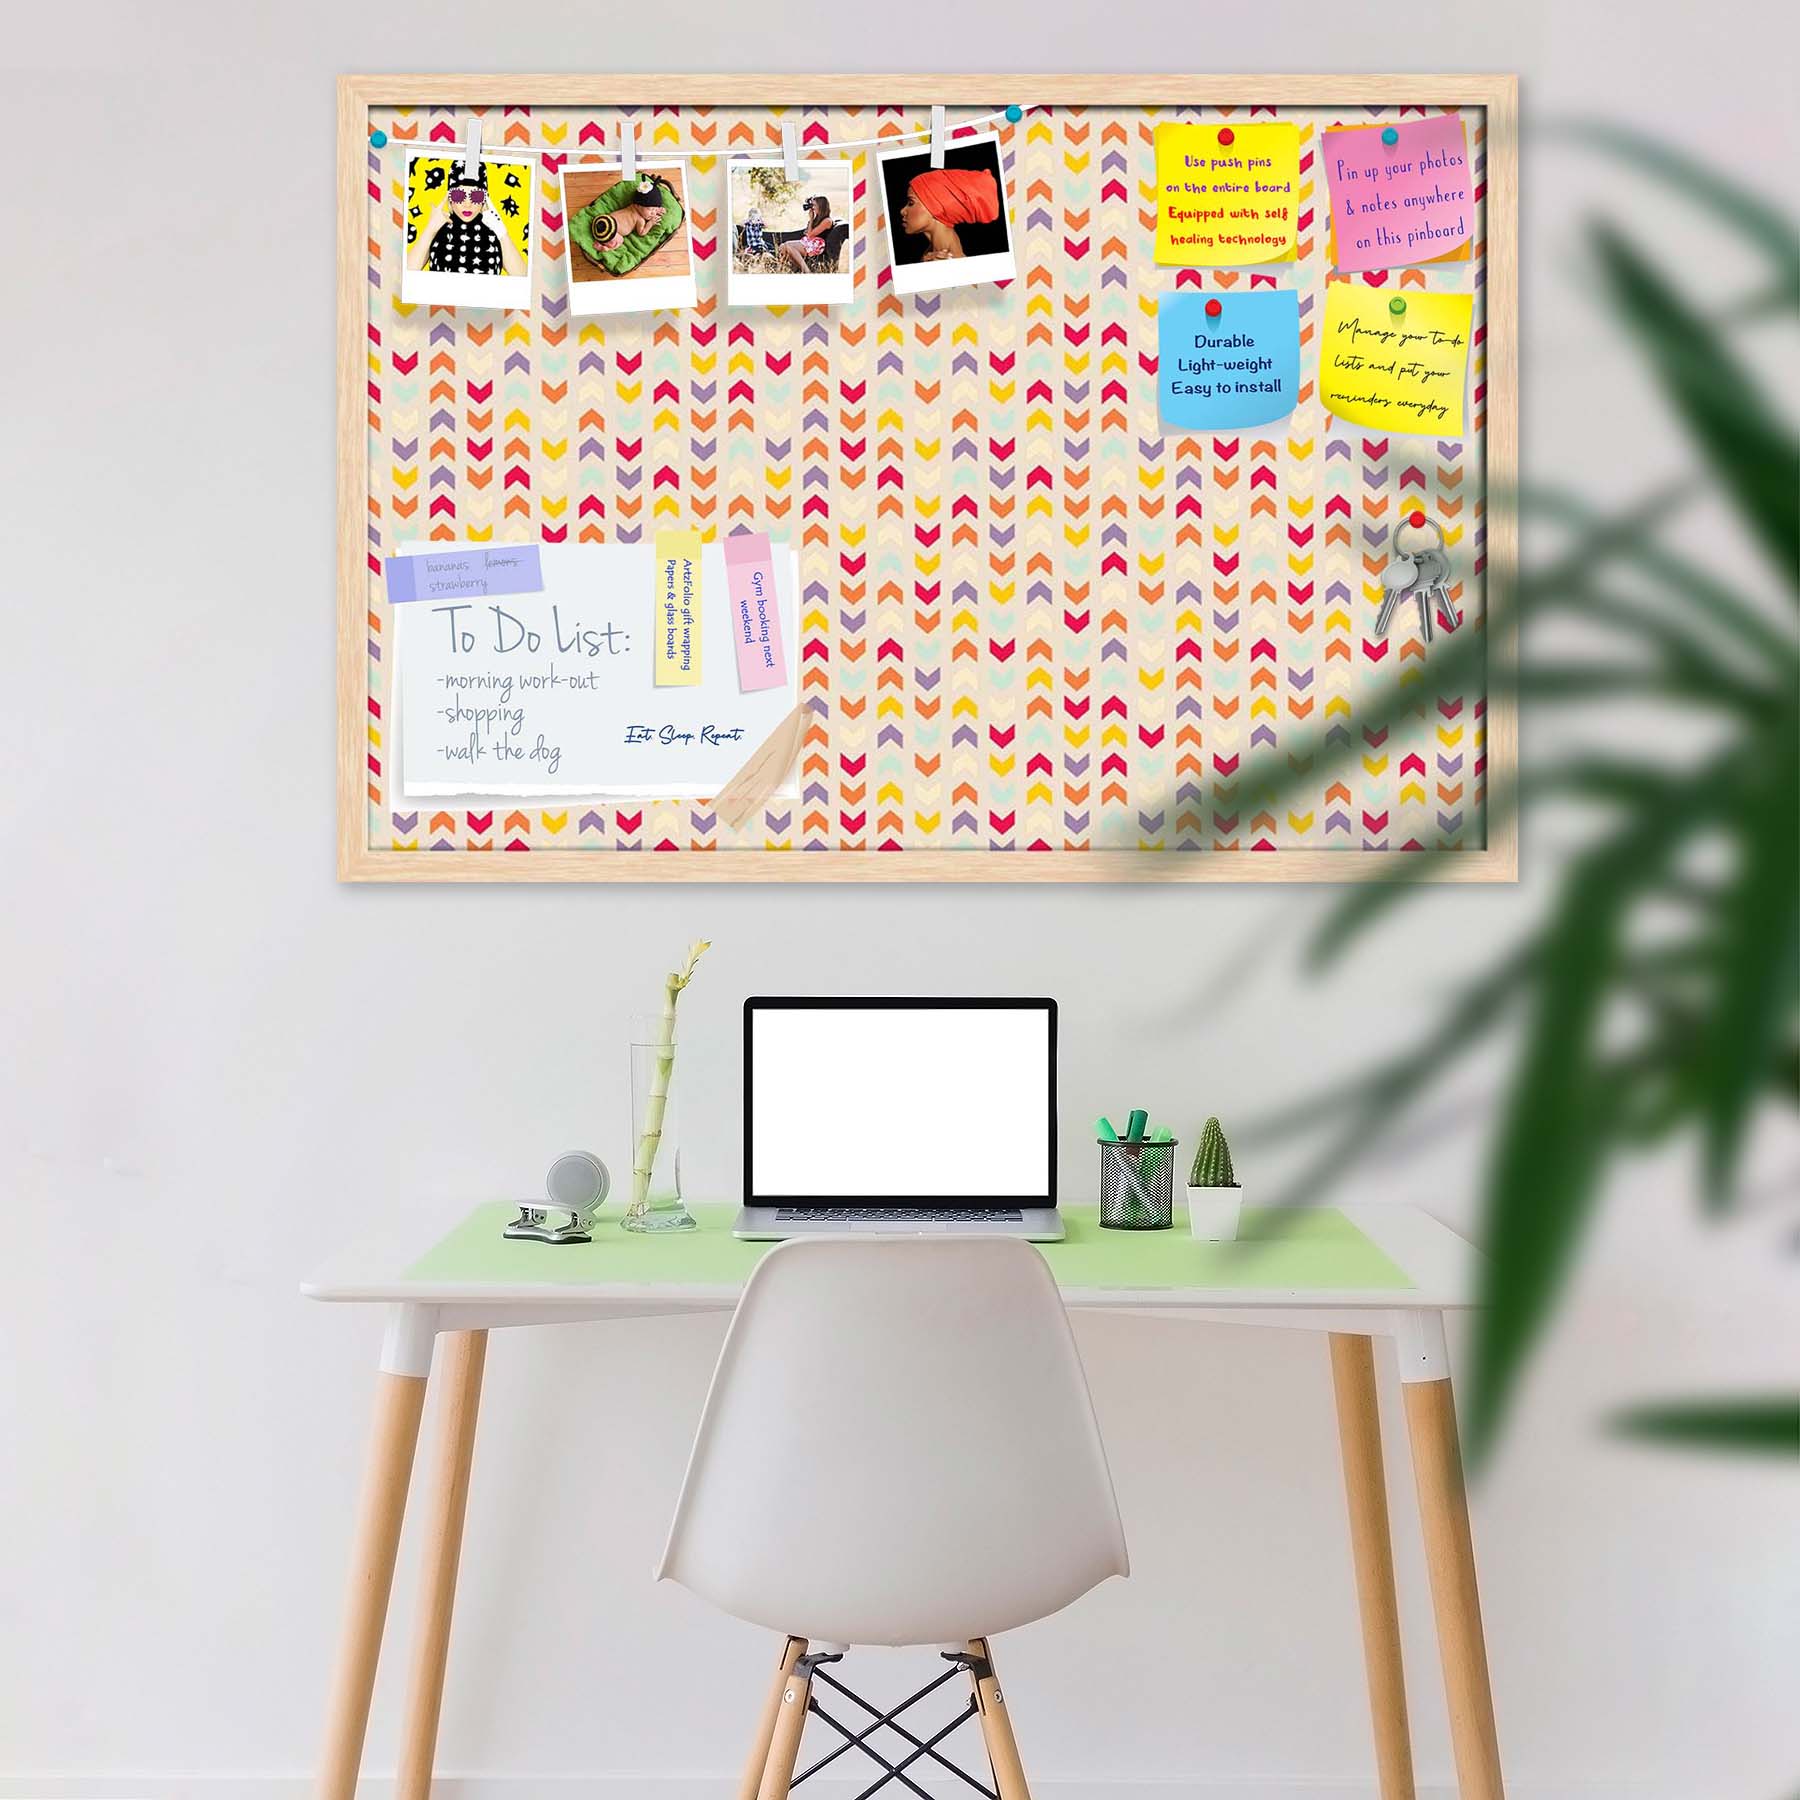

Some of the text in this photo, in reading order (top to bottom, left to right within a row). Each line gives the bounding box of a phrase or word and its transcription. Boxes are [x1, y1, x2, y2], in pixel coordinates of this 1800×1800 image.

[1185, 155, 1272, 172] Use push pins
[1337, 149, 1463, 182] Pin up your photos
[1166, 181, 1291, 194] on the entire board
[1346, 184, 1465, 216] & notes anywhere
[1168, 206, 1288, 223] Equipped with self
[1170, 233, 1287, 247] healing technology
[1356, 215, 1465, 249] on this pinboard
[1194, 334, 1255, 349] Durable
[1337, 318, 1397, 344] Manage
[1398, 332, 1428, 347] your
[1178, 356, 1273, 375] Light-weight
[1368, 361, 1397, 374] and
[1397, 363, 1425, 381] put
[1421, 371, 1451, 384] your
[1171, 378, 1282, 398] Easy to install
[1330, 392, 1449, 420] reminders everyday
[425, 551, 524, 573] bananas lemons
[428, 574, 489, 594] strawberry
[664, 559, 678, 660] Papers & glass boards
[680, 558, 695, 672] ArtzFolio gift wrapping
[740, 599, 757, 645] weekend
[751, 571, 776, 668] Gym booking next
[432, 604, 631, 657] To Do List:
[436, 662, 601, 704] -morning work-out
[436, 692, 526, 736] -shopping
[436, 731, 562, 775] -walk the dog
